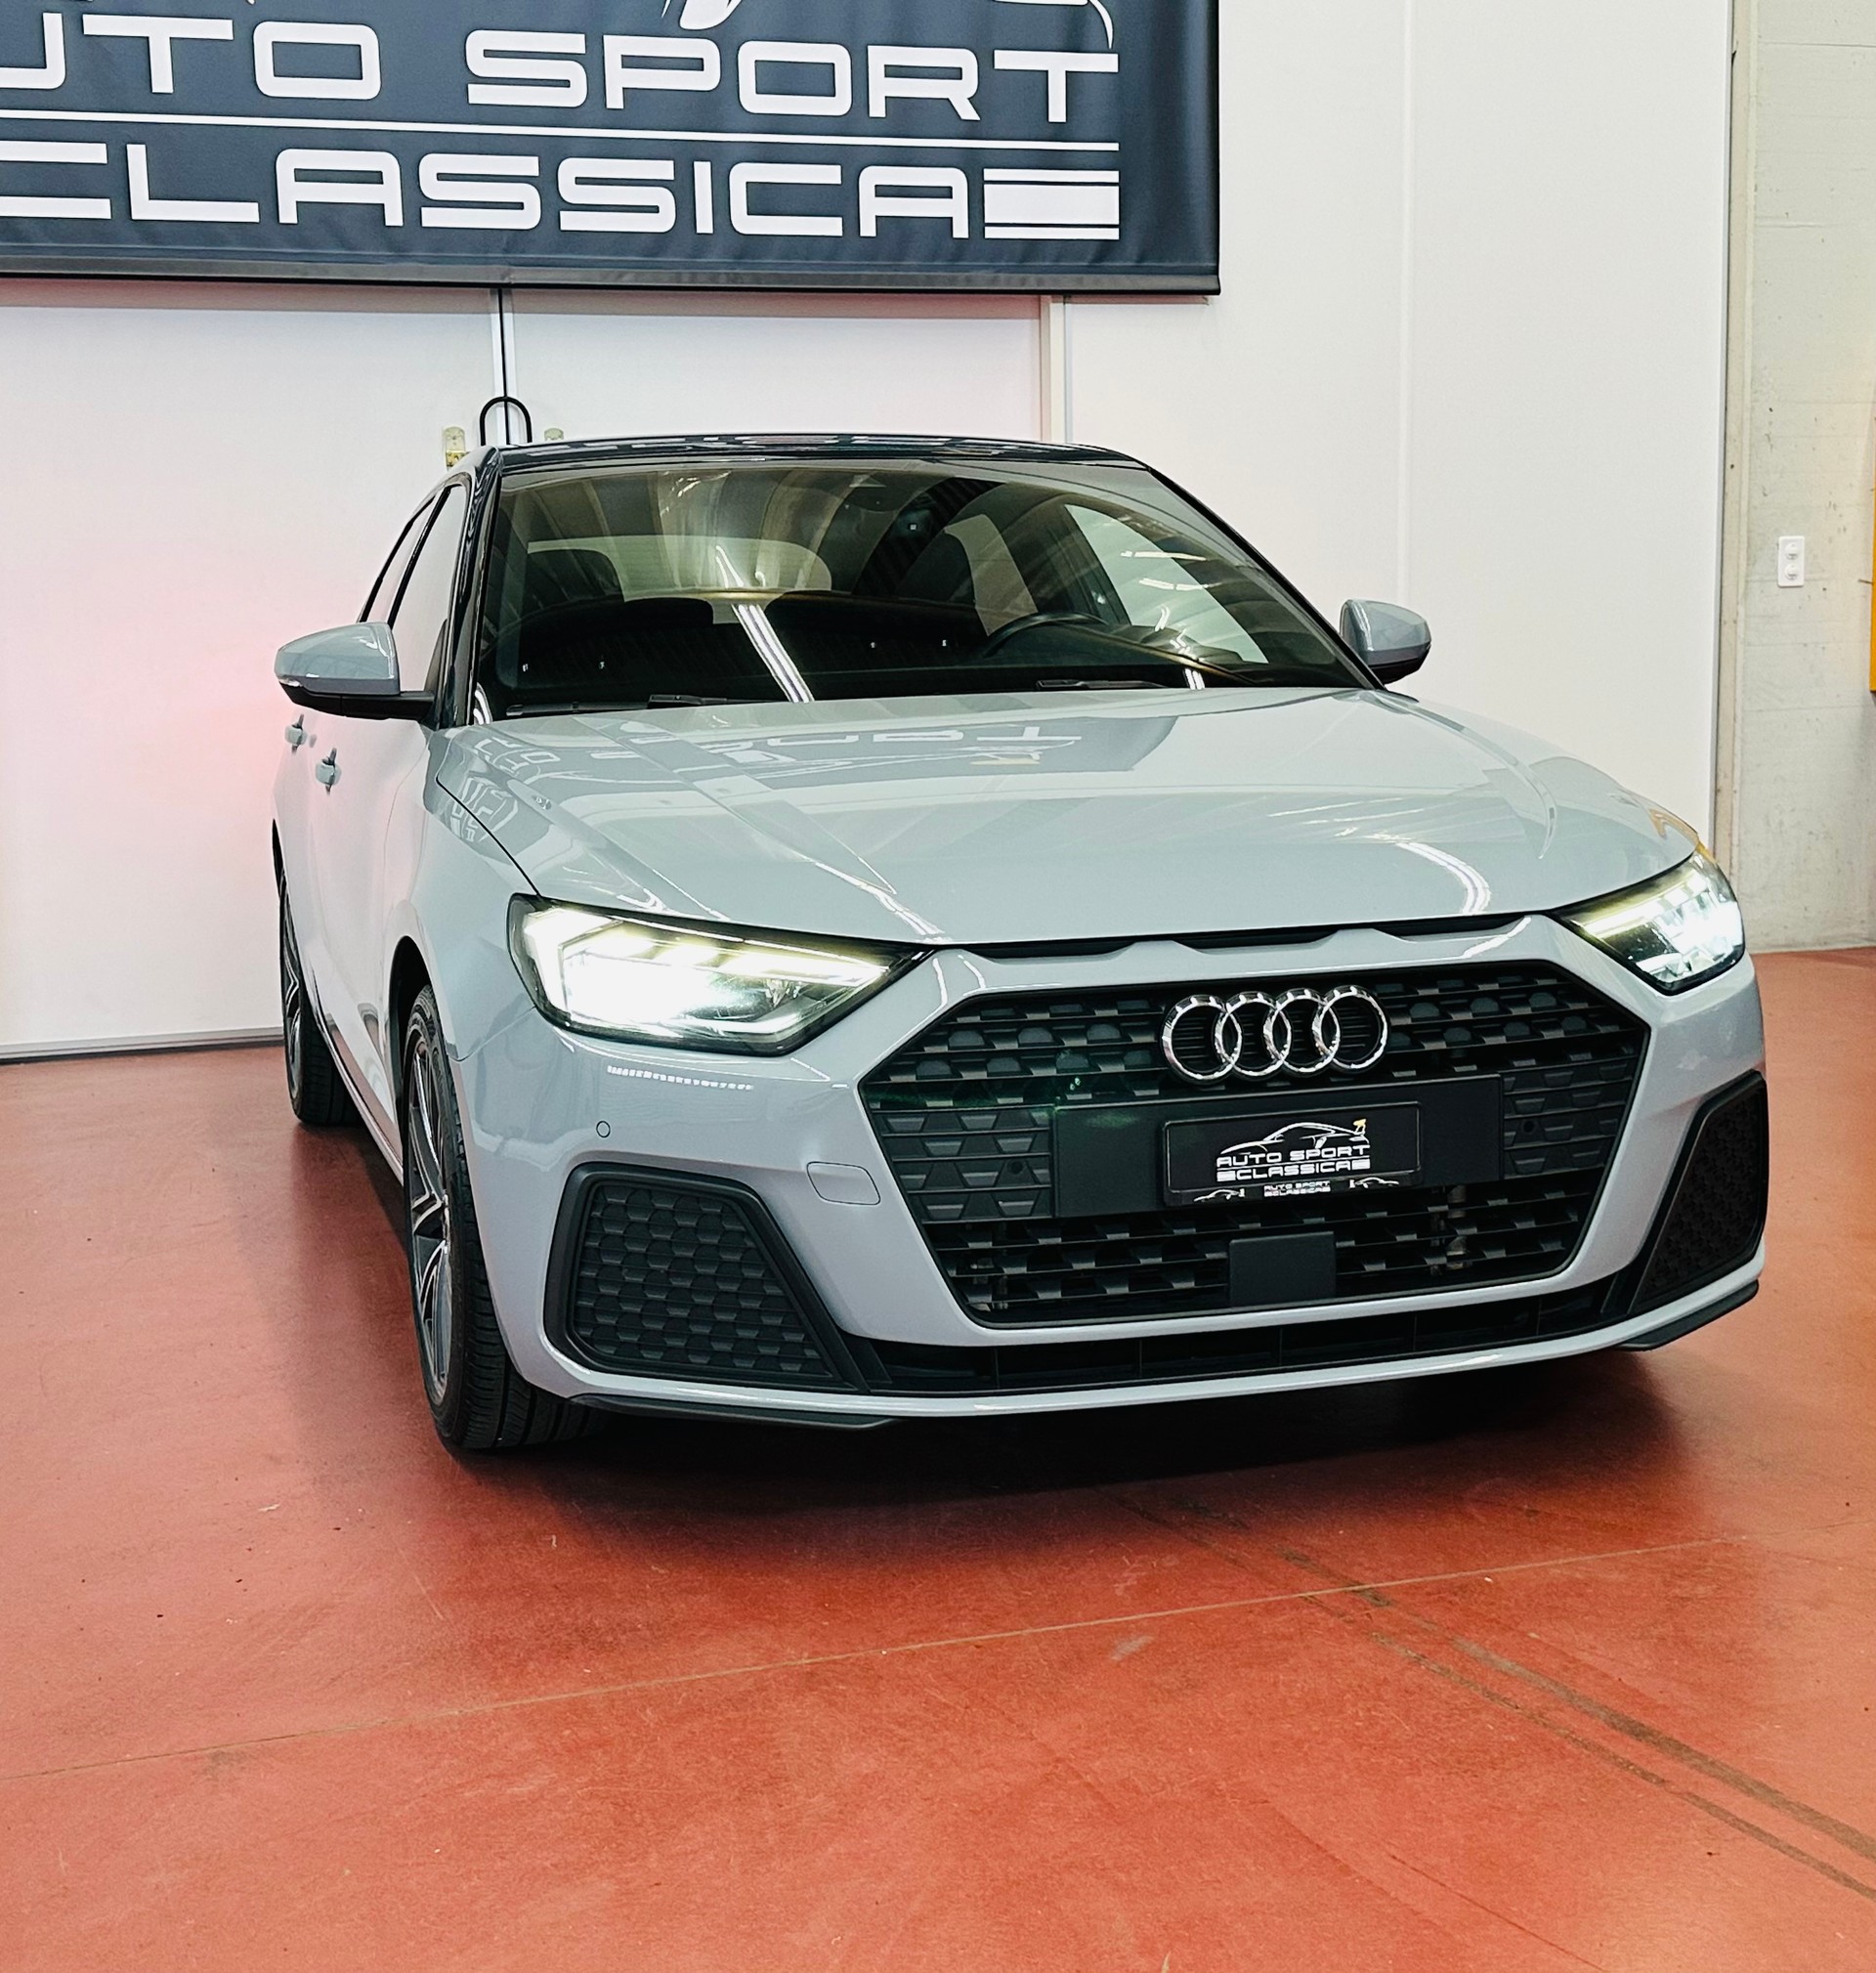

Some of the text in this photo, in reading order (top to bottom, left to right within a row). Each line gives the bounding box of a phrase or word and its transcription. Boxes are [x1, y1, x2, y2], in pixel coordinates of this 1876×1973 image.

[464, 28, 1119, 123] SPORT
[0, 139, 969, 238] CLASSICA
[1216, 1144, 1370, 1168] AUTO SPORT
[1236, 1160, 1351, 1180] CLASSICA
